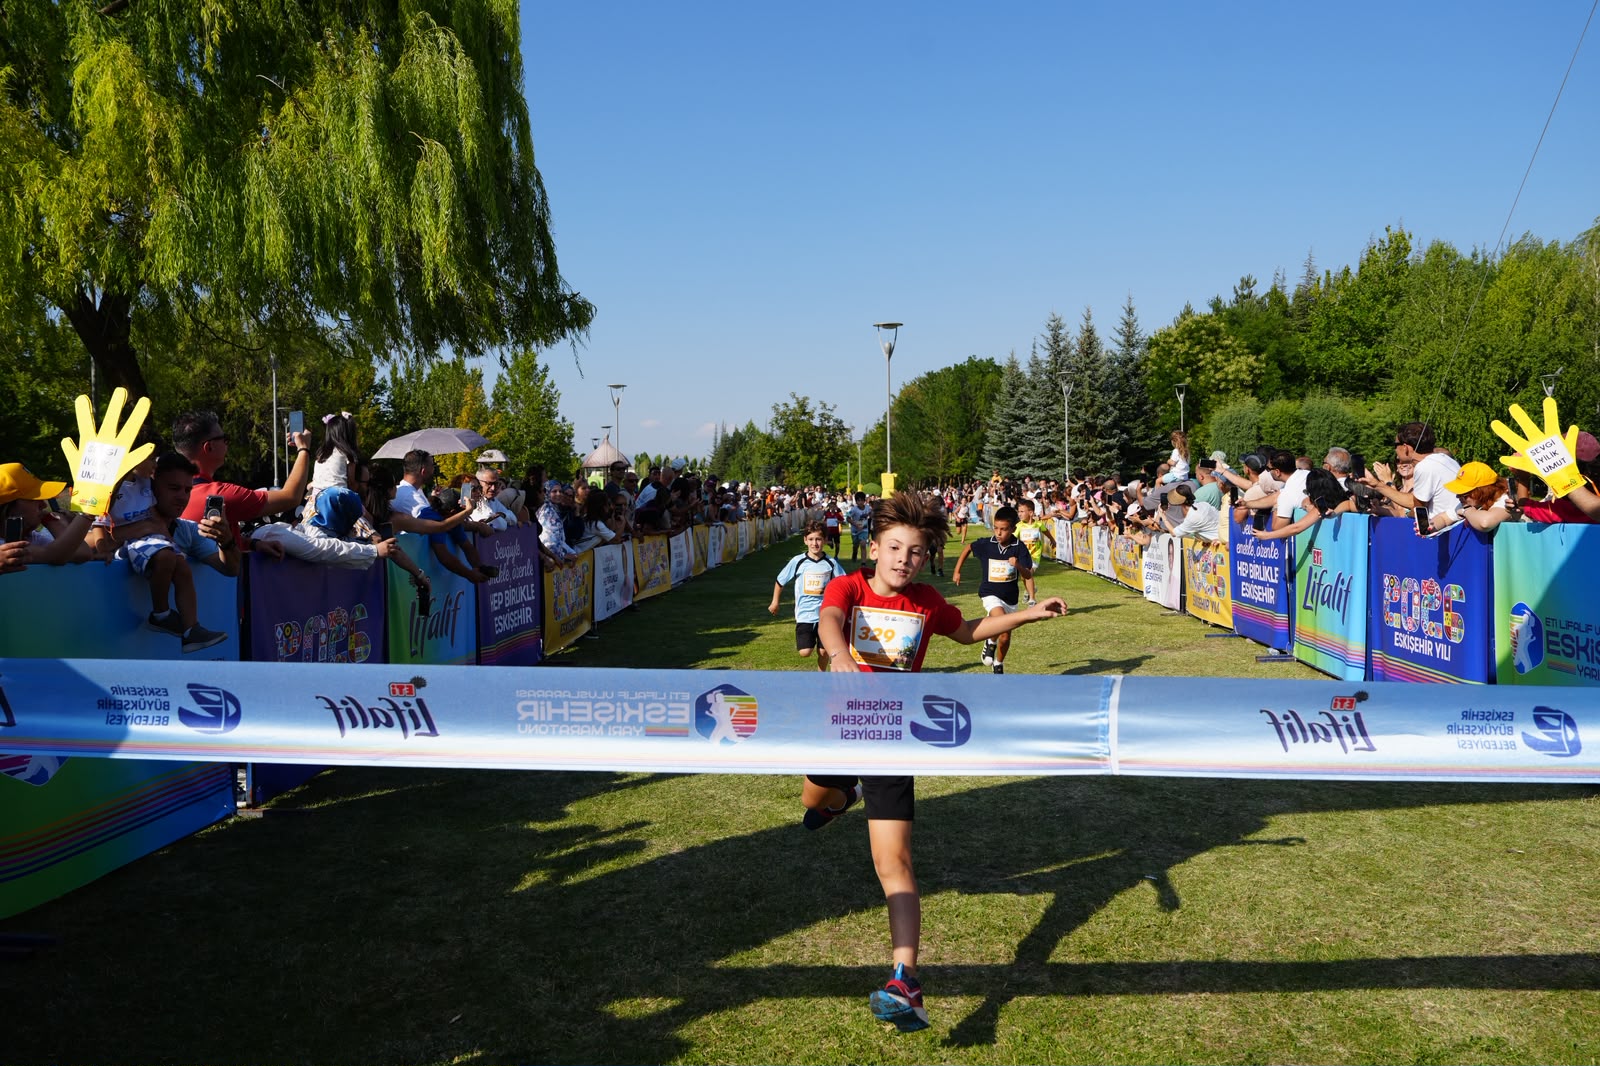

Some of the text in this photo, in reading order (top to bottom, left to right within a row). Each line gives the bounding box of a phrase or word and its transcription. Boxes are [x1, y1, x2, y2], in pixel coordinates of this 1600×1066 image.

[1542, 457, 1567, 473] UMUT
[1237, 560, 1279, 584] HEP BİRLİKLE
[1242, 581, 1275, 604] ESKİŞEHİR
[1303, 565, 1354, 626] Lifalif
[494, 603, 532, 634] ESKİŞEHİR
[1383, 573, 1466, 644] 2026
[858, 626, 896, 643] 329
[1394, 631, 1451, 661] ESKİŞEHİR YILI
